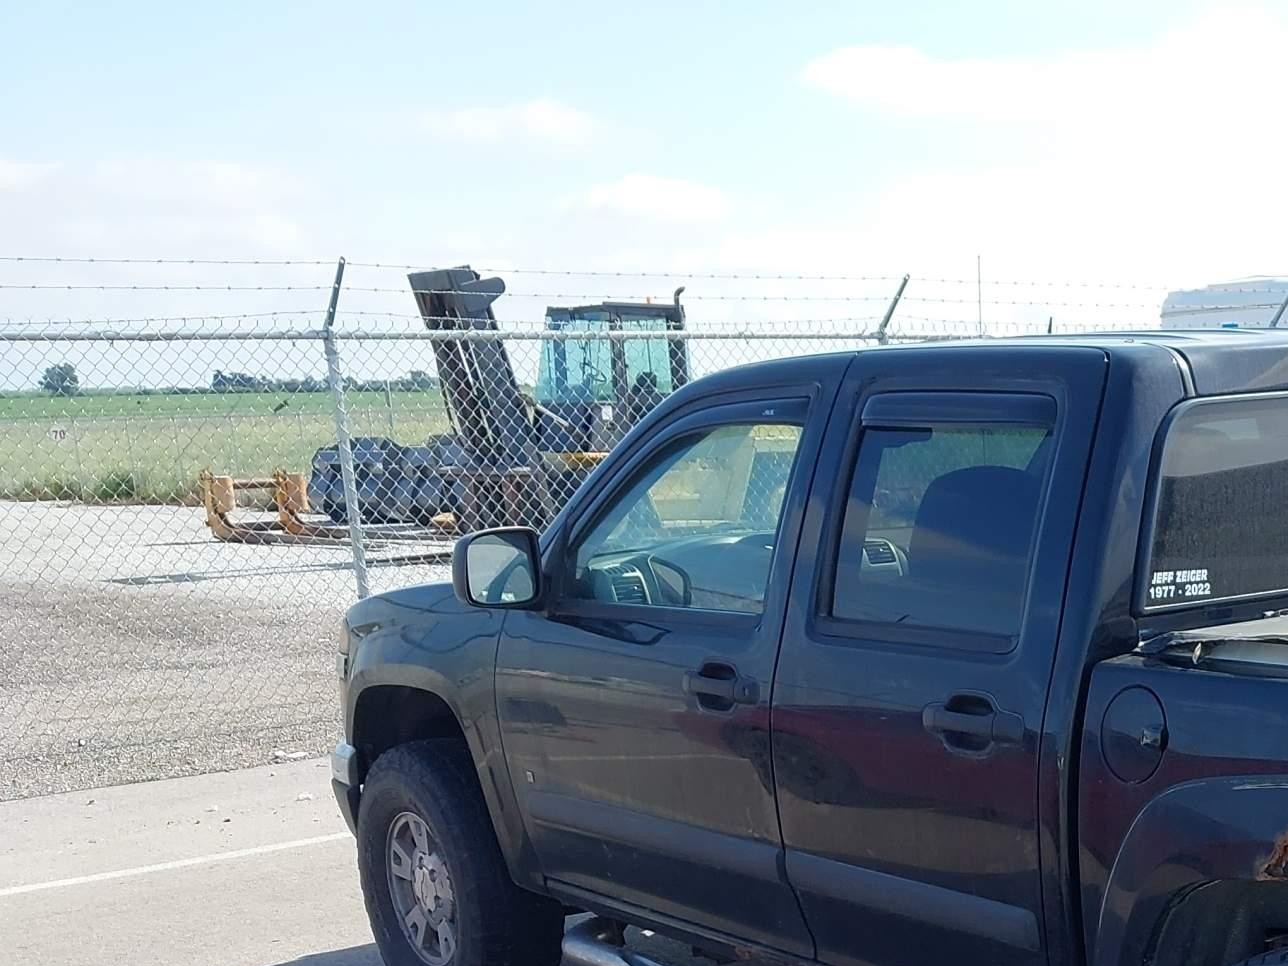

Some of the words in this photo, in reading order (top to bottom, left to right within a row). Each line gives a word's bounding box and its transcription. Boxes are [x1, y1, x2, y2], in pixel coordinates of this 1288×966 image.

[1151, 571, 1175, 584] JEFF
[1150, 585, 1175, 599] 1977
[1185, 582, 1211, 596] 2022
